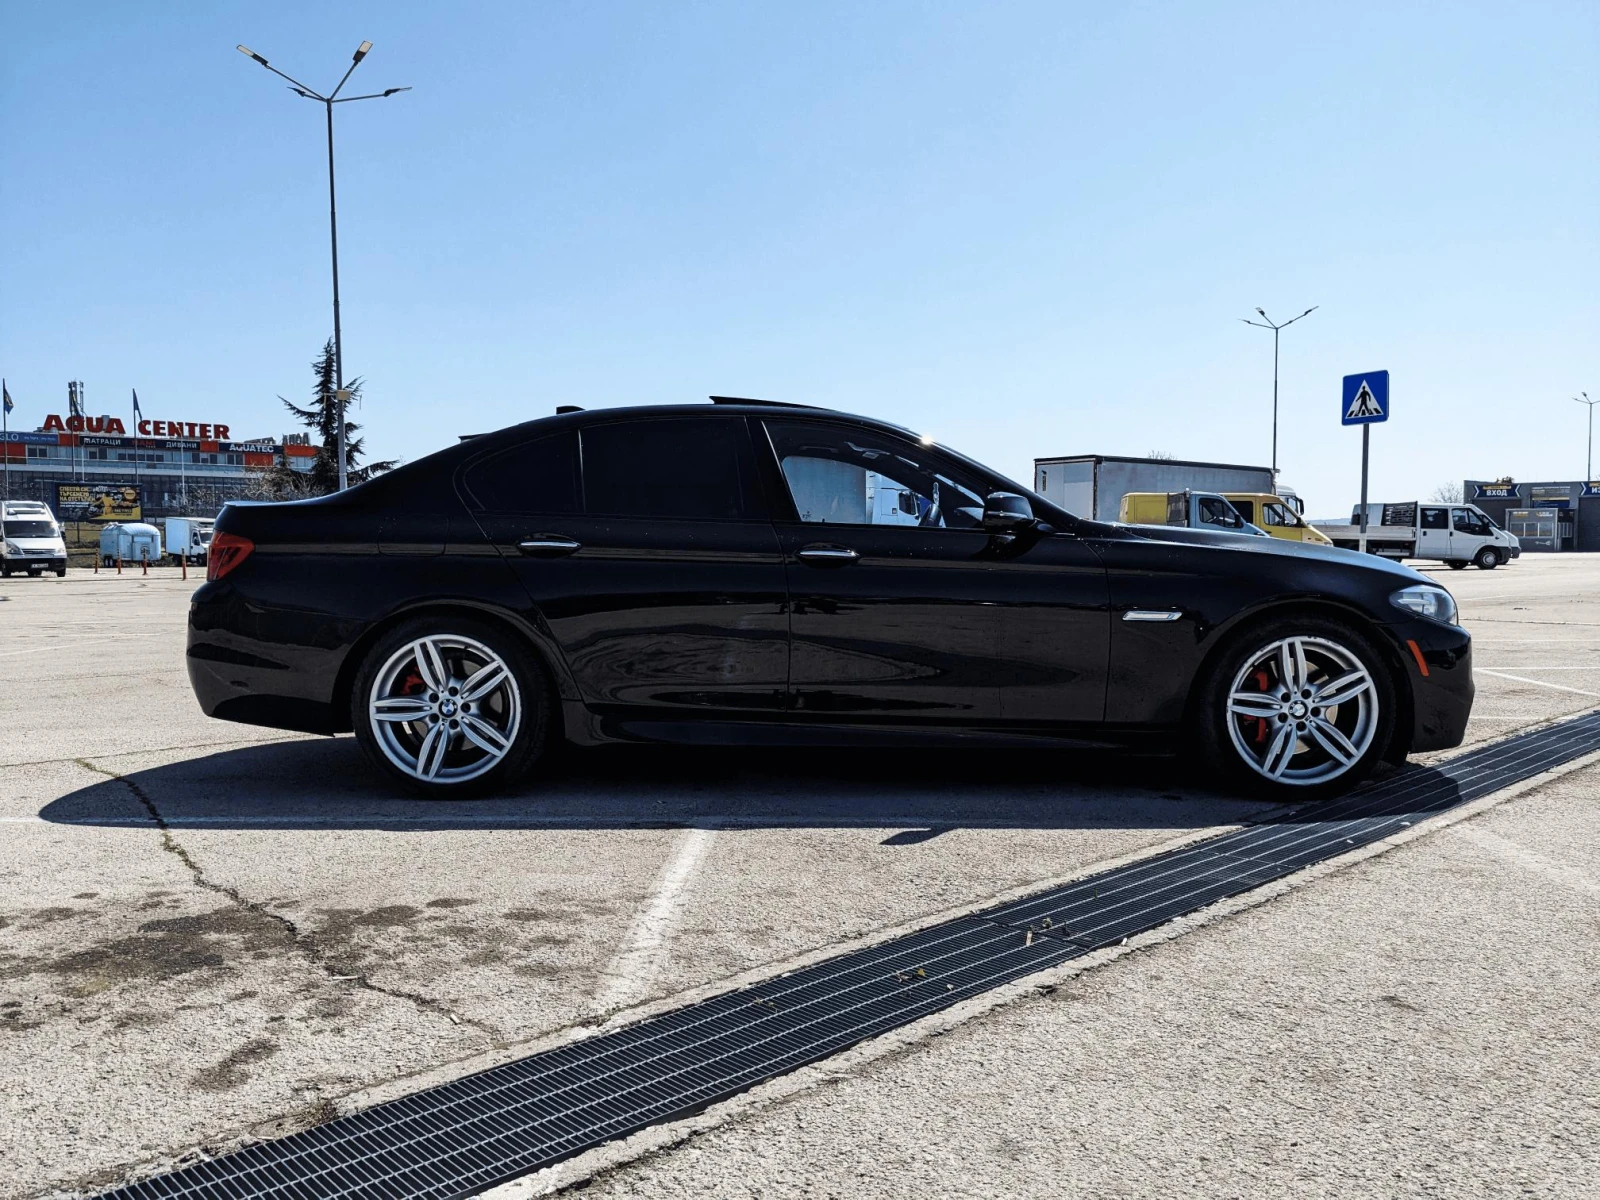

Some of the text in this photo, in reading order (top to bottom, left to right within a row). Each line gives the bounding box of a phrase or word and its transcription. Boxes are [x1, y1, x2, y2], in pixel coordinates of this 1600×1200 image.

[43, 414, 230, 439] AQUA CENTER
[83, 437, 121, 446] МАТРАЦИ
[166, 441, 197, 449] ДИВАНИ
[229, 444, 274, 453] AQUATEC
